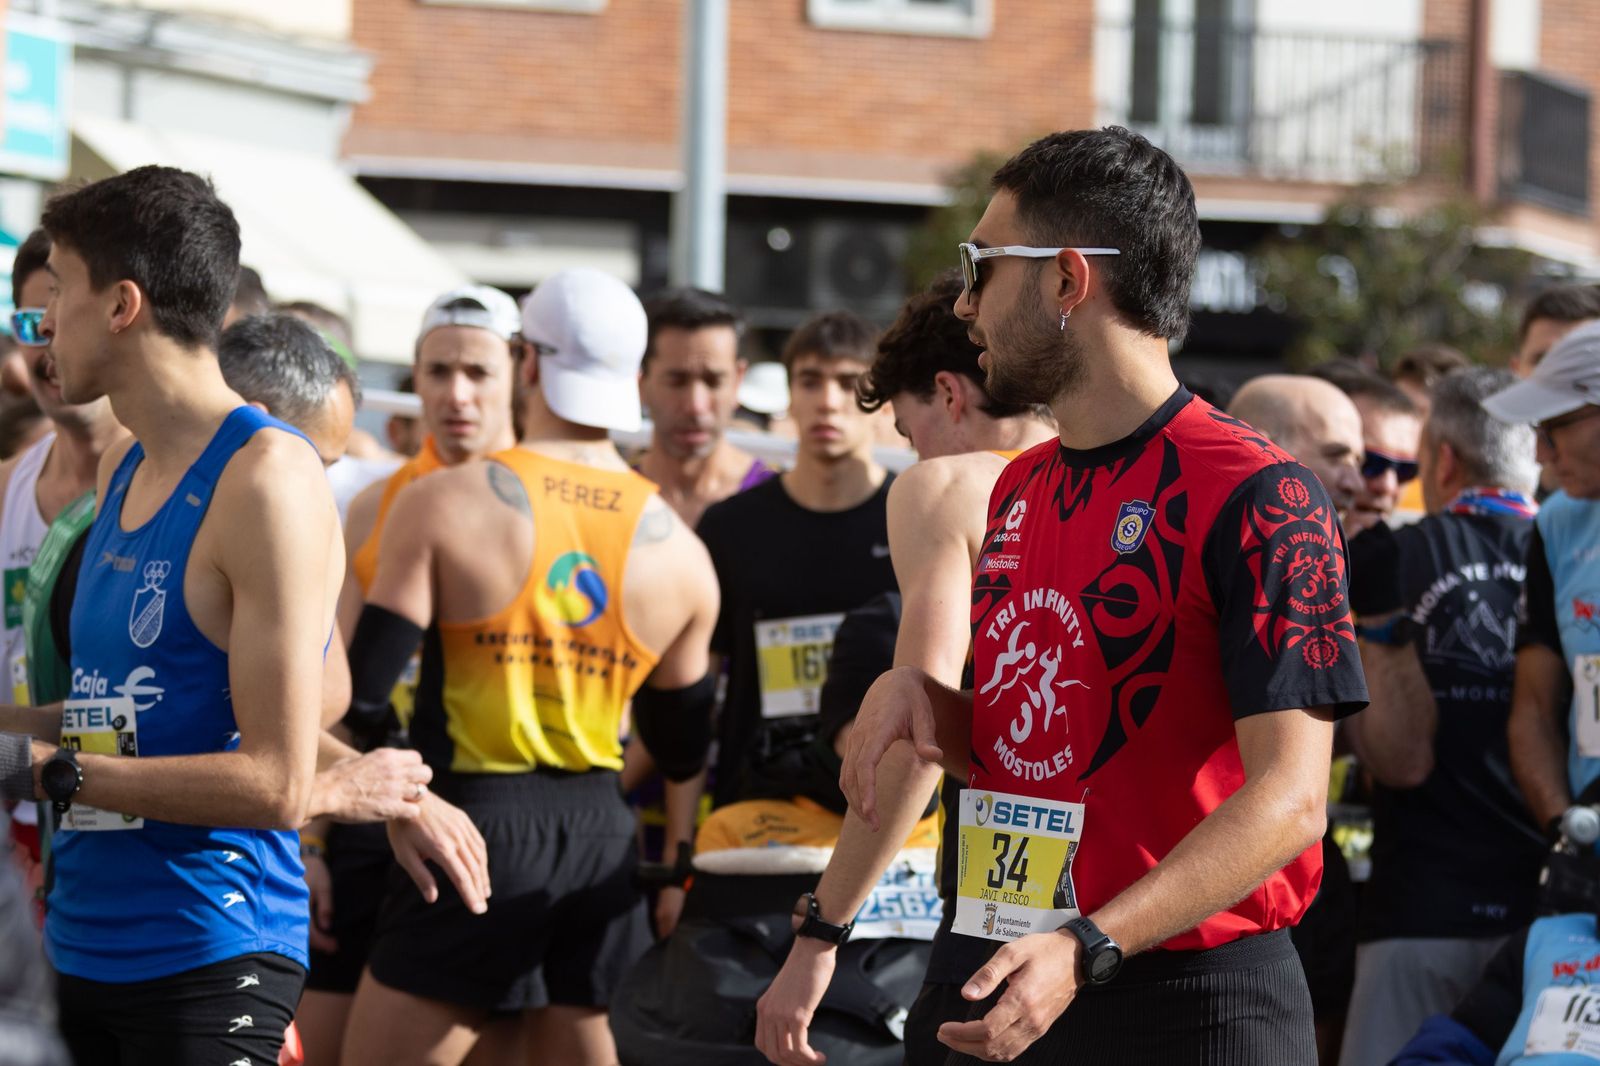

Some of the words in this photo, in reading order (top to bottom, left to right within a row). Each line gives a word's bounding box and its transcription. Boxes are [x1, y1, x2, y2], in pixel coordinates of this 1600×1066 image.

[543, 476, 622, 512] PÉREZ
[1127, 506, 1149, 516] GRUPO
[1272, 543, 1289, 564] TRI
[1288, 532, 1330, 549] INFINI
[986, 558, 1019, 570] Móstoles
[1287, 592, 1344, 615] MÓSTOLES
[986, 601, 1017, 642] TRI
[72, 667, 108, 698] Caja
[62, 706, 113, 728] ETEL
[993, 735, 1073, 781] MÓSTOLES
[993, 802, 1074, 834] SETEL
[987, 832, 1030, 892] 34
[979, 888, 998, 901] JAVI
[1002, 892, 1030, 906] RISCO
[995, 927, 1002, 935] de
[1002, 928, 1028, 939] Salaman
[997, 915, 1032, 929] Ayuntamiento
